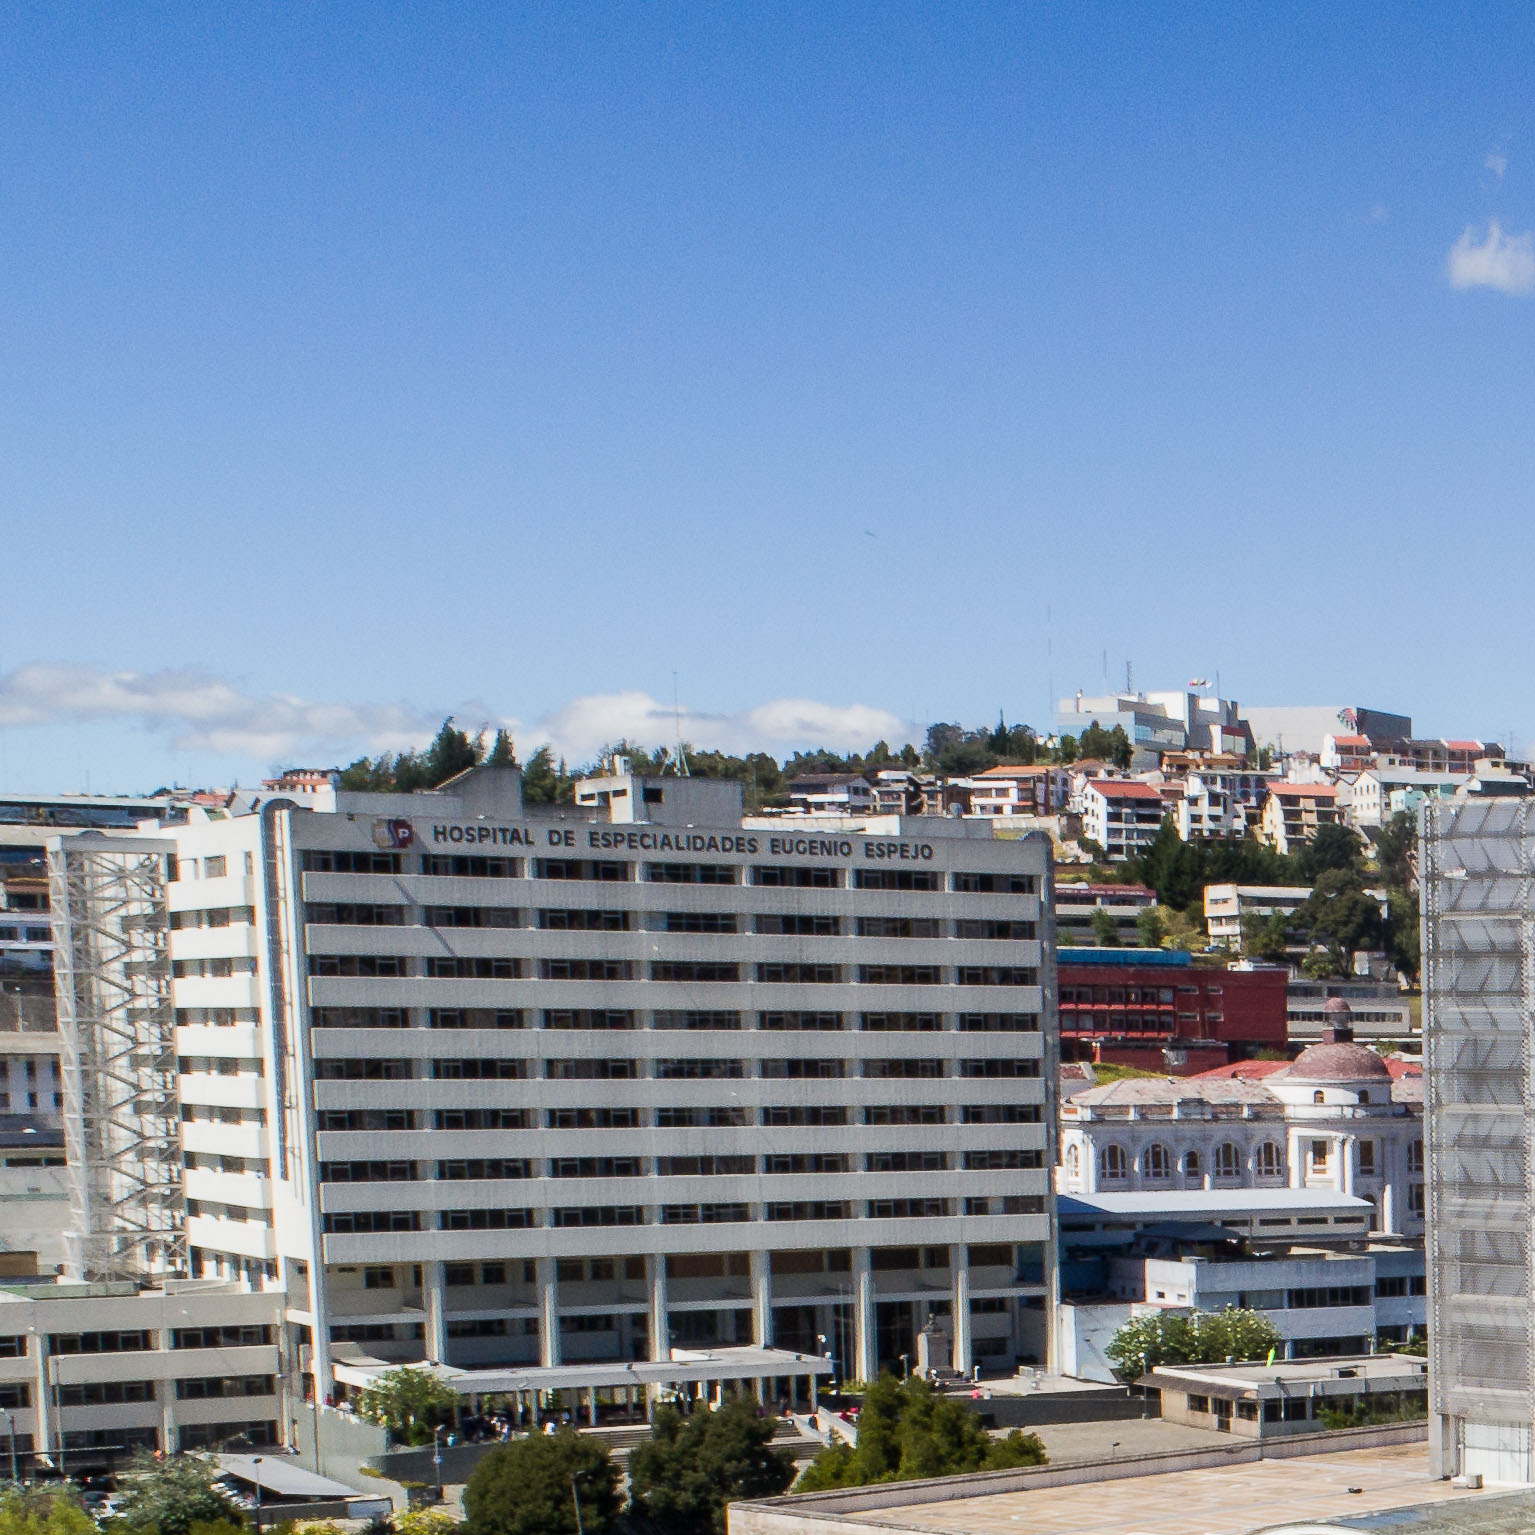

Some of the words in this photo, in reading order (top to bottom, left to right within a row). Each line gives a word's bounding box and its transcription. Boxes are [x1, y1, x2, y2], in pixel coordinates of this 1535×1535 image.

[433, 825, 535, 846] HOSPITAL
[548, 830, 575, 847] DE
[588, 831, 759, 853] ESPECIALIDADES
[770, 838, 853, 856] EUGENIO
[864, 842, 934, 860] ESPEJO
